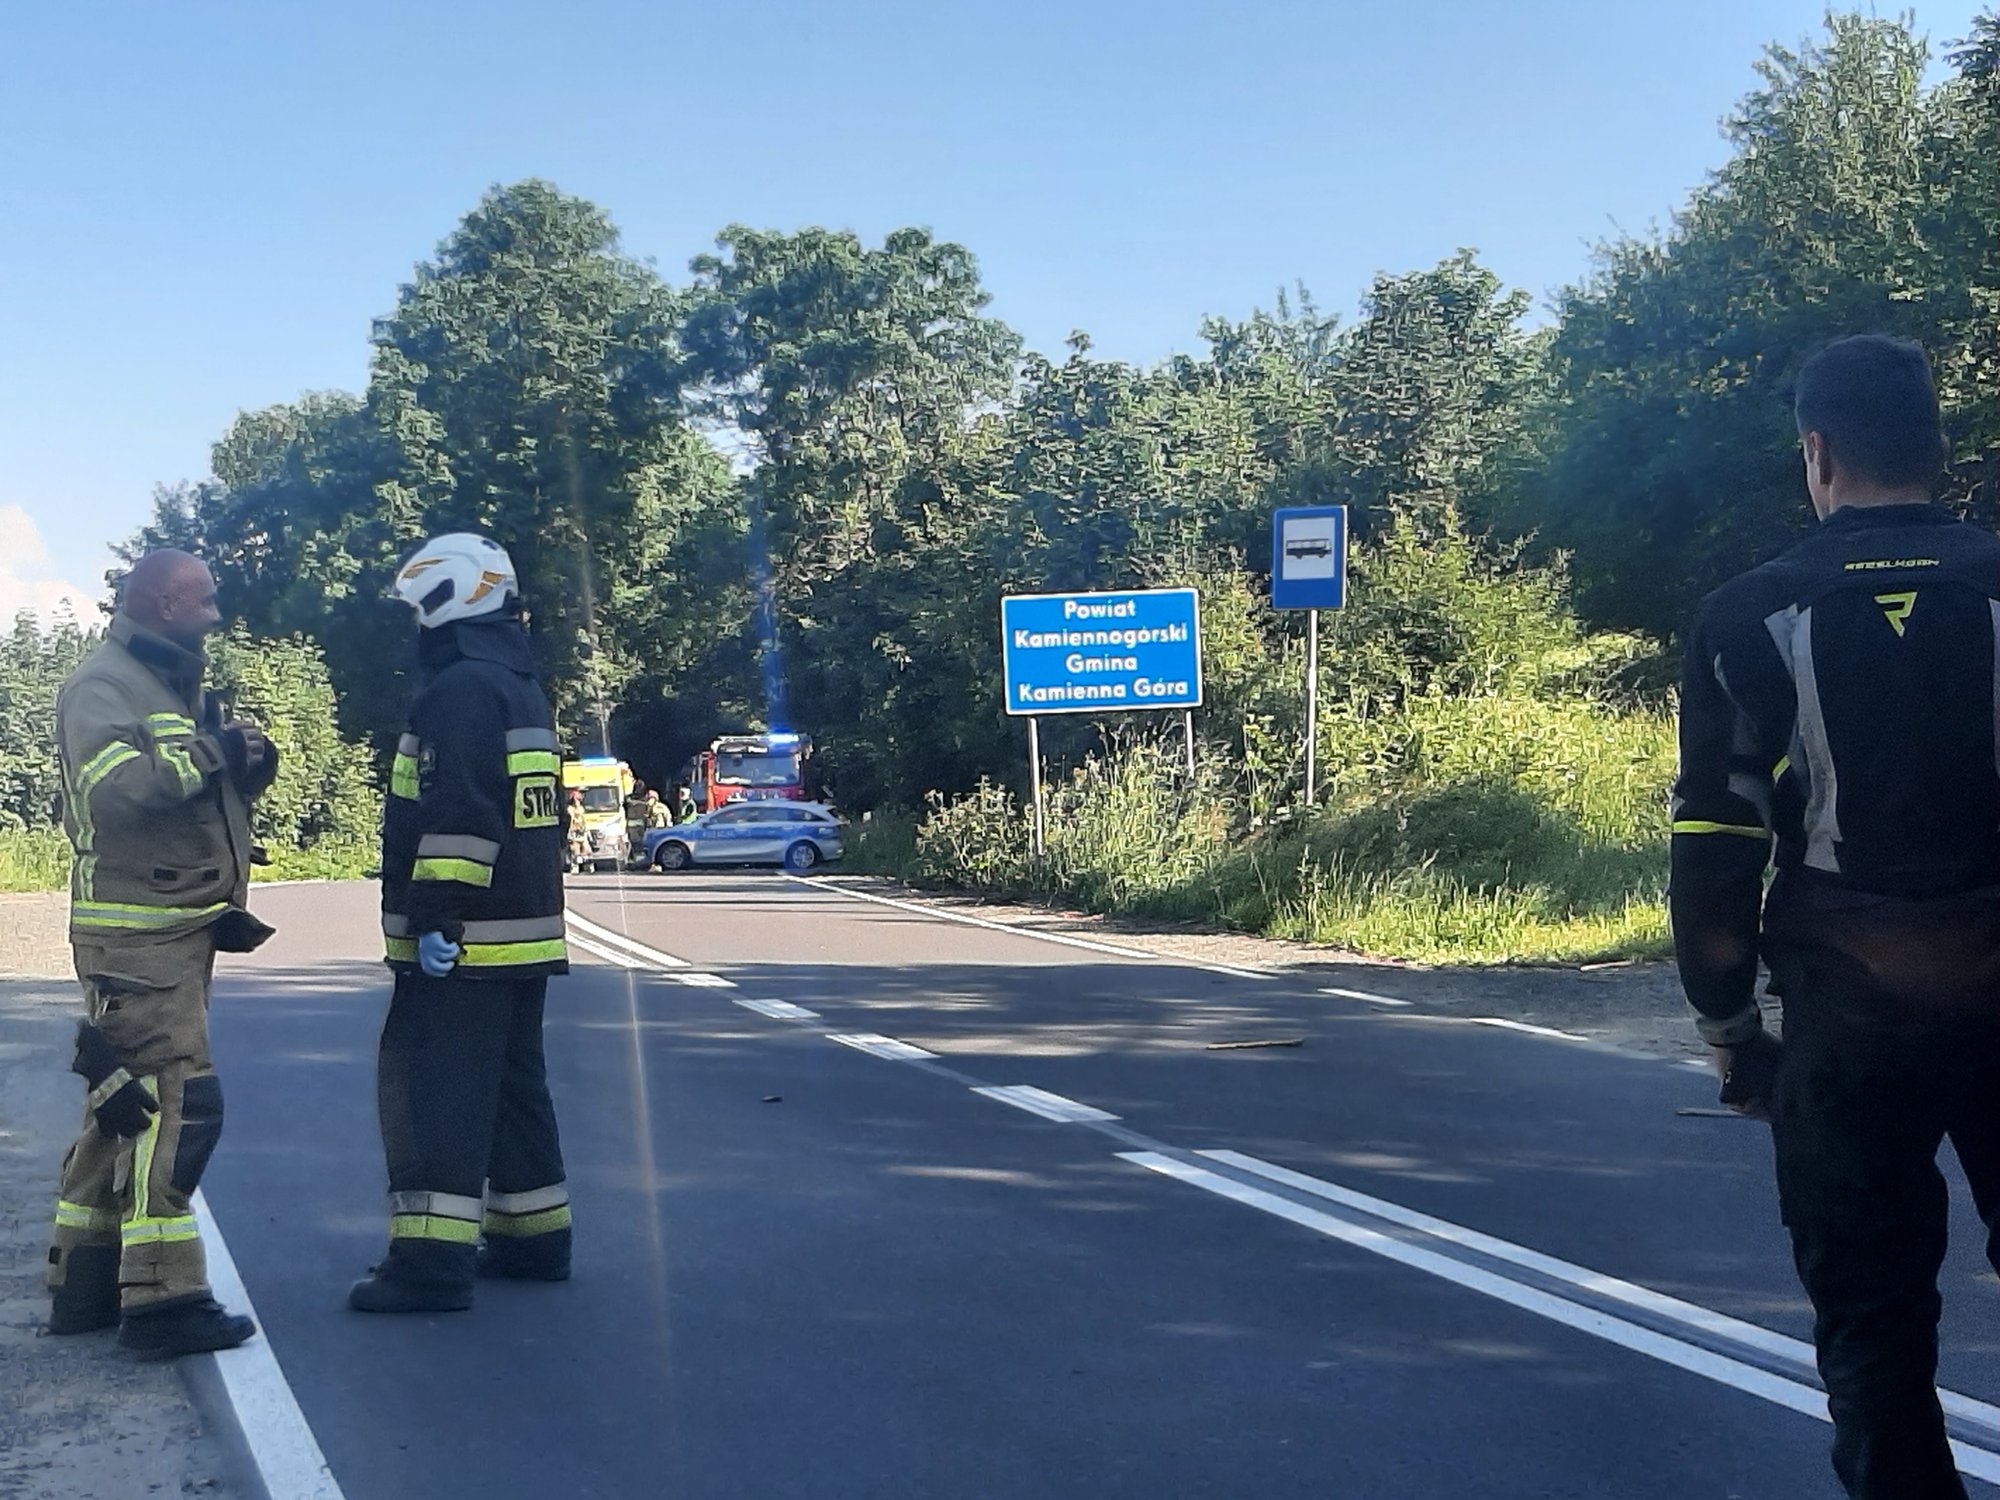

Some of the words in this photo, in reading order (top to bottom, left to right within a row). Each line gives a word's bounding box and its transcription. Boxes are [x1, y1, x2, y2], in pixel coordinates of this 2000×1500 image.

[1064, 599, 1136, 620] Powiat
[1014, 621, 1188, 649] Kamiennogórski
[1066, 653, 1138, 673] Gmina
[1018, 682, 1126, 702] Kamienna
[1133, 677, 1188, 697] Góra
